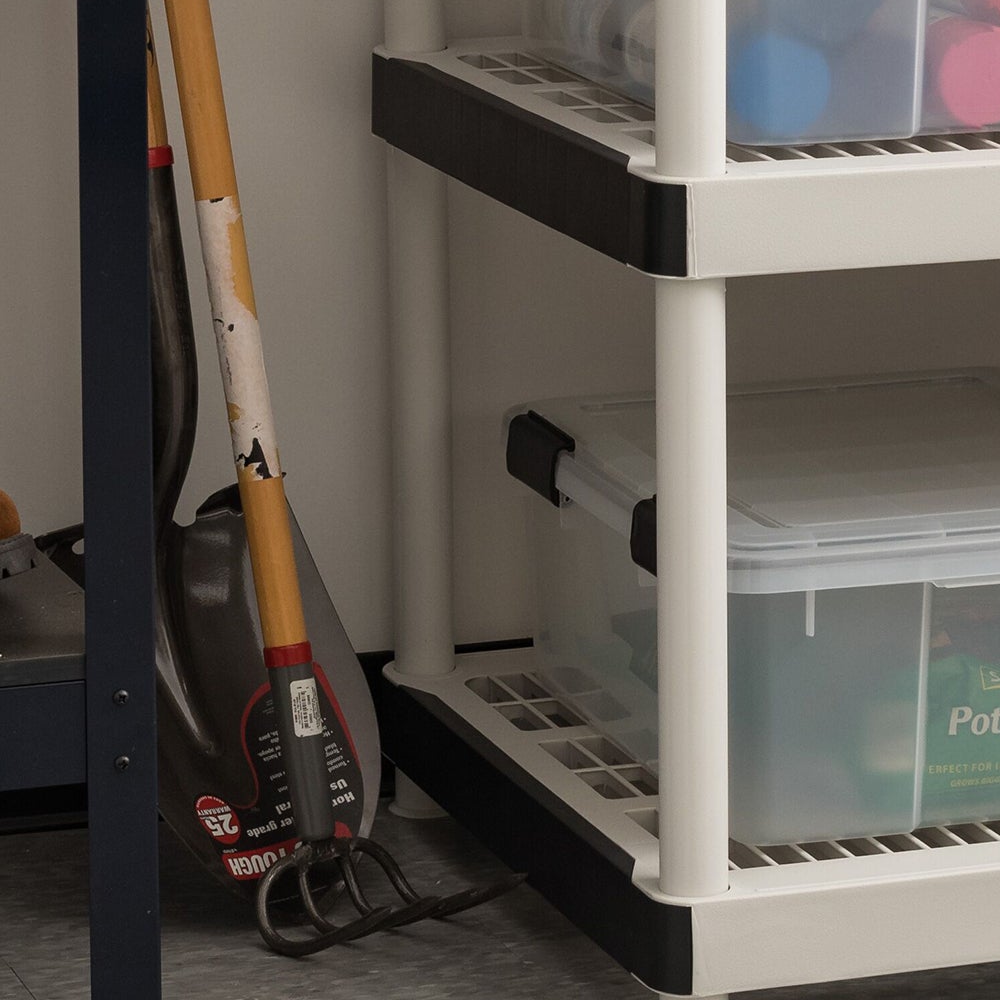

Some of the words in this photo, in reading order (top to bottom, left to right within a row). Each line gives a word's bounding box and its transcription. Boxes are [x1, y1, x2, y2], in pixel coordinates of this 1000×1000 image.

[971, 761, 992, 773] FOR
[329, 779, 349, 791] Us
[331, 791, 356, 809] Hor
[196, 804, 232, 817] WARRANTY
[204, 813, 239, 837] 25
[246, 819, 278, 838] grade
